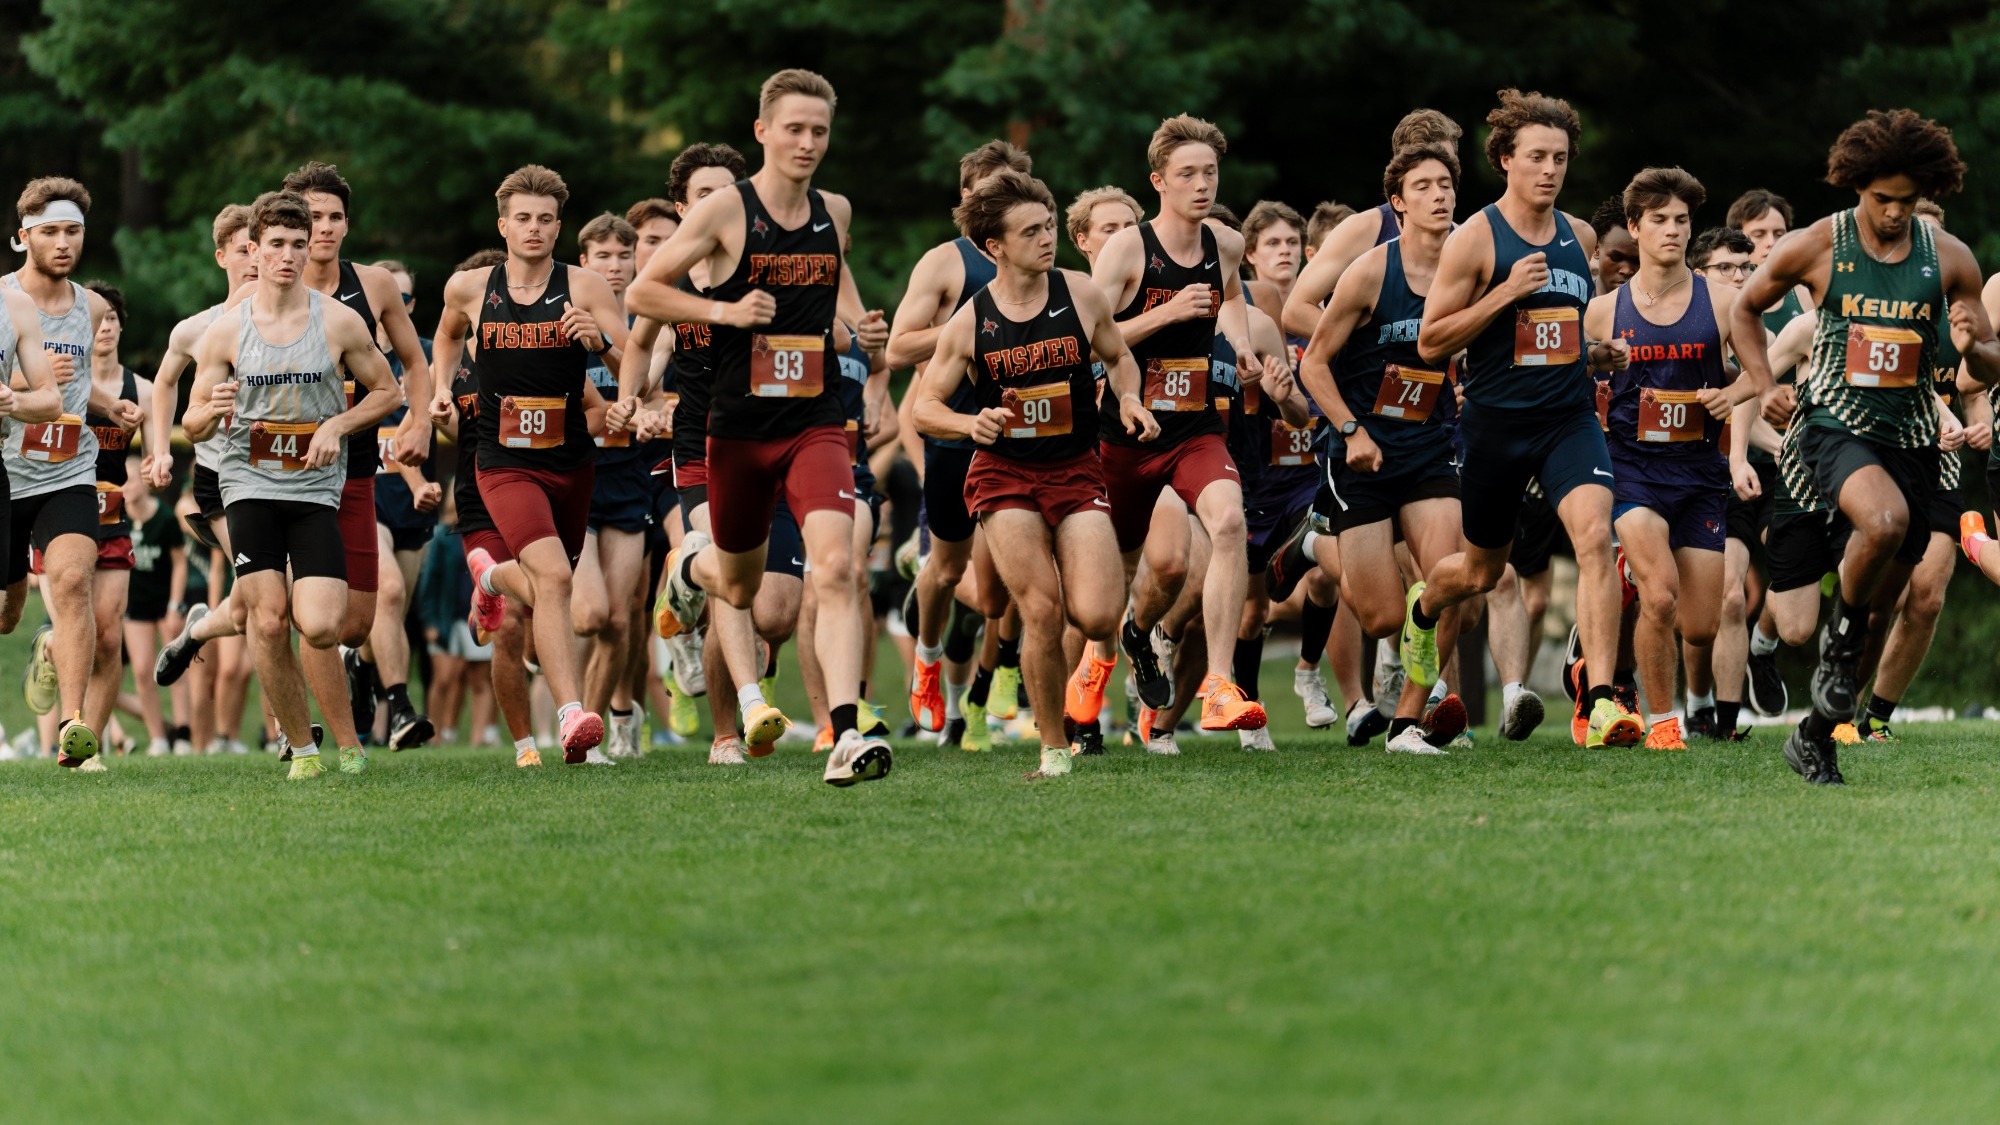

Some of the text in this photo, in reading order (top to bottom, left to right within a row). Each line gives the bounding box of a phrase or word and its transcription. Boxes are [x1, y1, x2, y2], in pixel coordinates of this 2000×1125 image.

[748, 254, 837, 286] FISHER
[1531, 268, 1588, 304] REND
[1841, 293, 1931, 320] KEUKA
[482, 320, 571, 349] FISHER
[1535, 322, 1562, 350] 83
[774, 350, 804, 381] 93
[984, 335, 1082, 381] FISHER
[1628, 343, 1705, 363] HOBART
[1868, 341, 1900, 372] 53
[246, 371, 323, 387] HOUGHTON
[1164, 371, 1191, 397] 85
[1397, 380, 1424, 406] 74
[519, 409, 546, 435] 89
[1023, 398, 1051, 425] 90
[1659, 403, 1687, 428] 30
[40, 424, 64, 449] 41
[270, 434, 298, 458] 44
[1290, 430, 1312, 453] 33
[98, 491, 107, 514] 6
